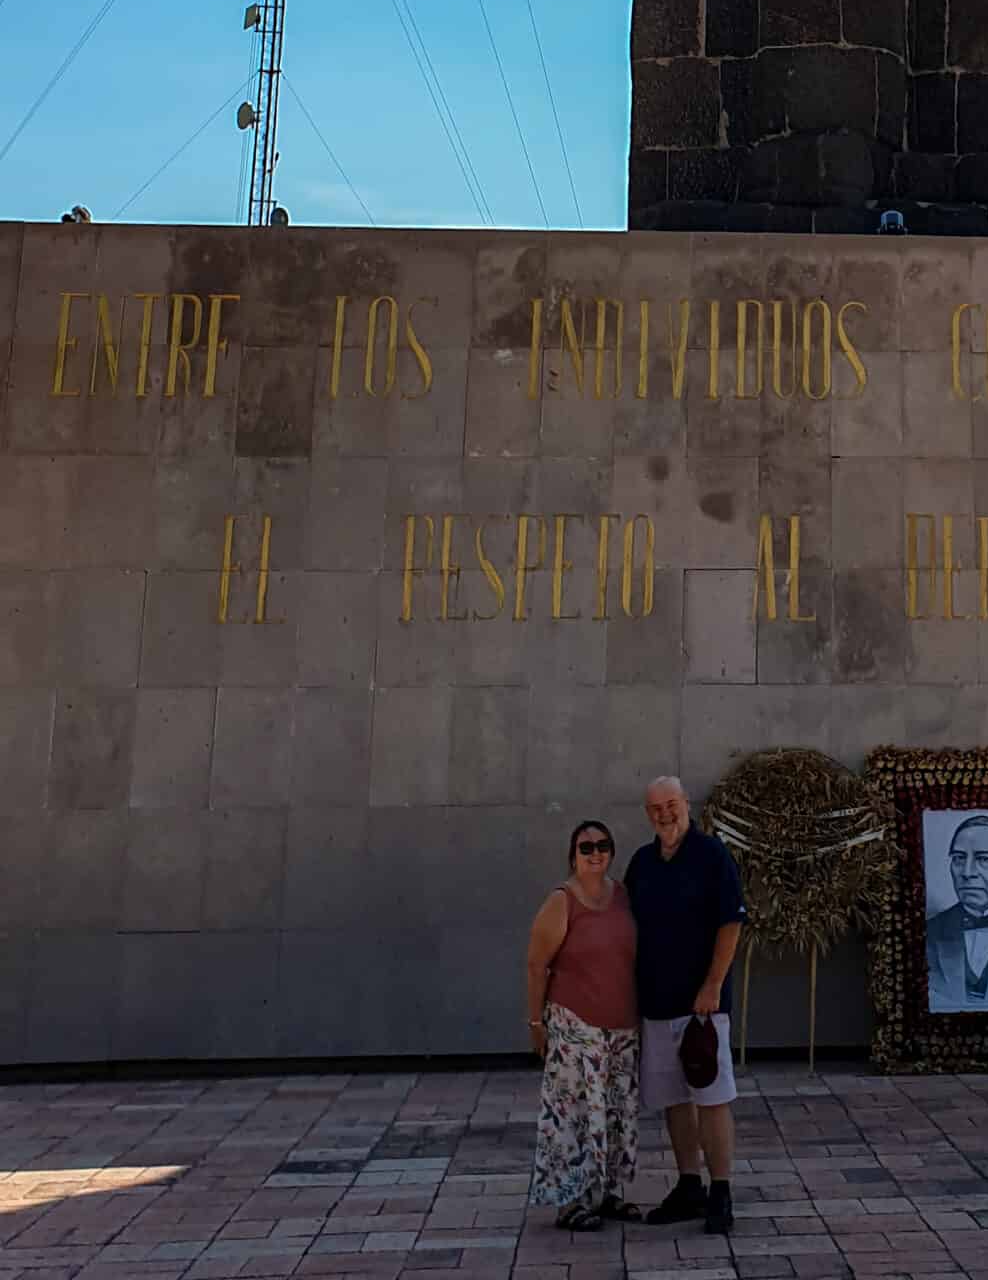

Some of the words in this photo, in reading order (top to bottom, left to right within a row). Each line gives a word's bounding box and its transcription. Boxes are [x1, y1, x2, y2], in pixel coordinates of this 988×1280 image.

[50, 292, 240, 399] ENTRE
[328, 295, 438, 400] LOS
[526, 297, 869, 400] INDIVIDUOS
[218, 515, 287, 625] EL
[399, 514, 656, 621] RESPETO
[753, 514, 816, 621] AL
